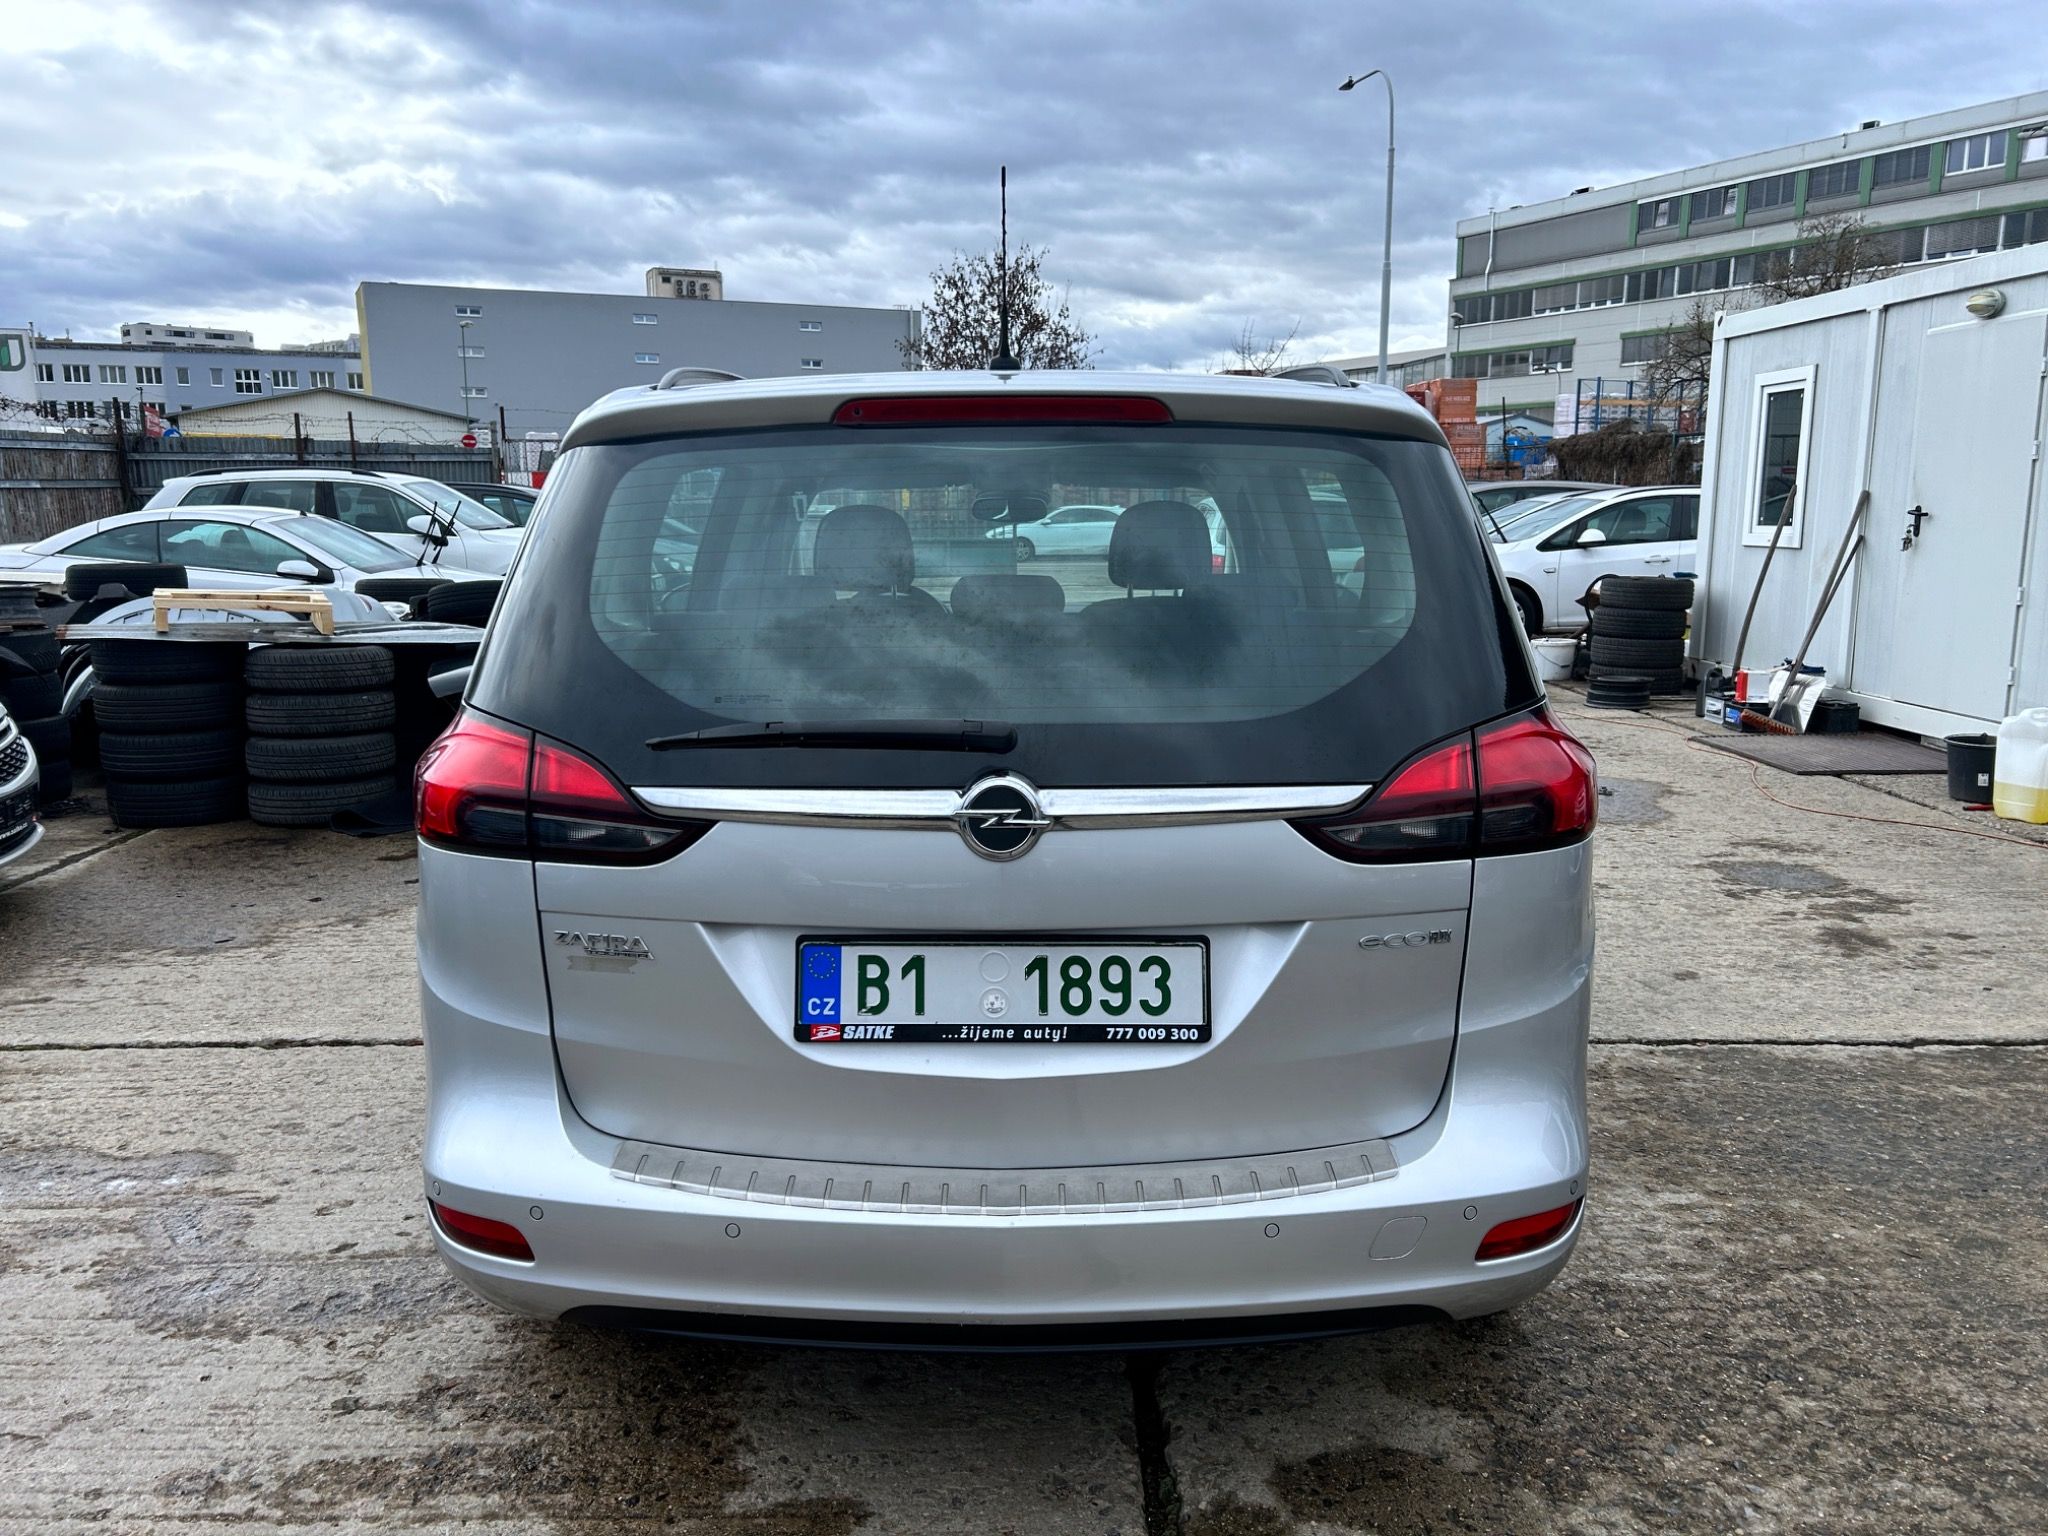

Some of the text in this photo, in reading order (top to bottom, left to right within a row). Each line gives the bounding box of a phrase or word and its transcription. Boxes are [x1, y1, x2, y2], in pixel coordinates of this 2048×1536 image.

[554, 930, 648, 950] ZAFIRA
[857, 955, 1171, 1016] B1 1893
[808, 997, 836, 1016] CZ
[843, 1026, 895, 1039] SATKE
[1024, 1026, 1068, 1042] auty!
[1106, 1028, 1198, 1041] 777 009 300
